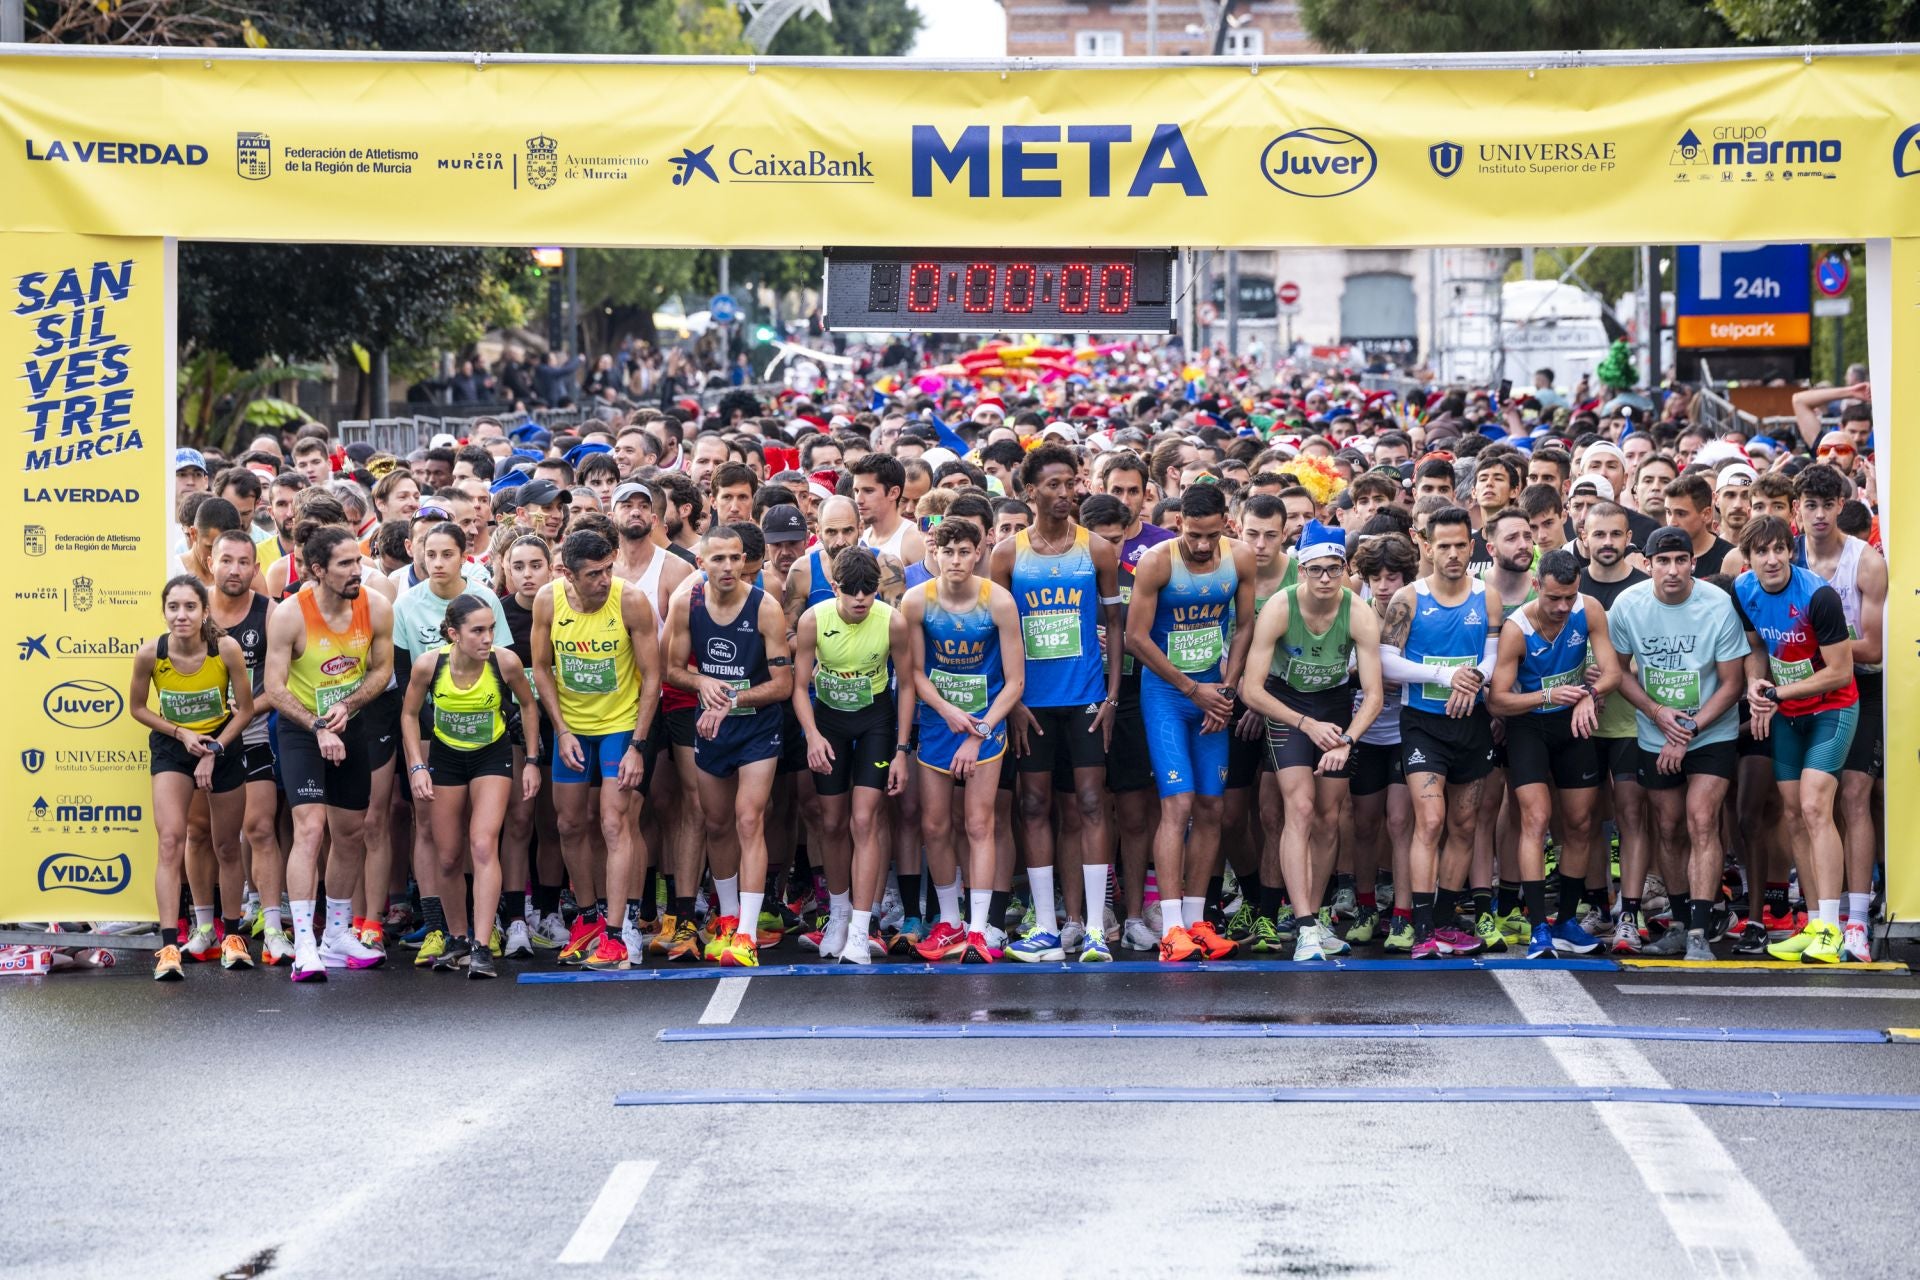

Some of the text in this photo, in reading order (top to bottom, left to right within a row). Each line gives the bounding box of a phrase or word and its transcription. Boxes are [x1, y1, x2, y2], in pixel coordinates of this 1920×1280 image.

[1713, 126, 1766, 141] Grupo
[26, 139, 209, 166] LA VERDAD
[285, 147, 418, 160] Federación de Atletismo
[1480, 142, 1616, 161] UNIVERSAE
[1713, 140, 1842, 165] marmo
[438, 160, 503, 170] MURCIA
[565, 154, 648, 167] Ayuntamiento
[728, 148, 874, 176] CaixaBank
[912, 124, 1208, 197] META
[1274, 150, 1364, 175] Juver
[285, 161, 412, 175] de la Región de Murcia
[565, 168, 627, 180] de Murcia
[1478, 162, 1615, 174] Instituto Superior de FP
[13, 260, 134, 315] SAN
[1734, 278, 1780, 298] 24h
[32, 305, 116, 357] SIL
[1710, 322, 1775, 340] telpark
[20, 344, 132, 400] VES
[22, 389, 134, 442] TRE
[24, 429, 144, 471] MURCIA
[24, 488, 140, 503] LA VERDAD
[55, 534, 140, 542] Federación de Atletismo
[74, 543, 100, 552] Región
[98, 588, 151, 598] Ayuntamiento
[1025, 588, 1082, 608] UCAM
[109, 598, 138, 606] Murcia
[1173, 604, 1225, 622] UCAM
[1028, 618, 1046, 628] SAN
[1028, 616, 1074, 636] SILVESTRE
[56, 636, 144, 654] CaixaBan
[1036, 633, 1069, 647] 3182
[1174, 630, 1218, 650] SILVESTRE
[1175, 634, 1194, 643] SAN
[555, 640, 620, 653] nawter
[1640, 635, 1696, 656] SAN
[710, 648, 732, 658] Reina
[1181, 647, 1213, 661] 1326
[326, 657, 359, 673] Serrano
[566, 660, 611, 672] SILVESTRE
[574, 672, 602, 684] 073
[936, 678, 982, 688] SILVESTRE
[1303, 676, 1332, 684] 792
[1550, 676, 1567, 686] SAN
[1650, 674, 1694, 684] SILVESTRE
[322, 688, 341, 700] SAN
[830, 690, 859, 702] 092
[942, 690, 974, 702] 1719
[1656, 687, 1686, 700] 476
[52, 696, 115, 713] Juver
[174, 704, 210, 716] 1022
[440, 712, 488, 724] SILVESTRE
[452, 724, 476, 734] 156
[56, 750, 148, 763] UNIVERSAE
[90, 764, 123, 772] Superior
[56, 795, 92, 807] Grupo
[56, 806, 142, 822] marmo
[52, 866, 118, 882] VIDAL
